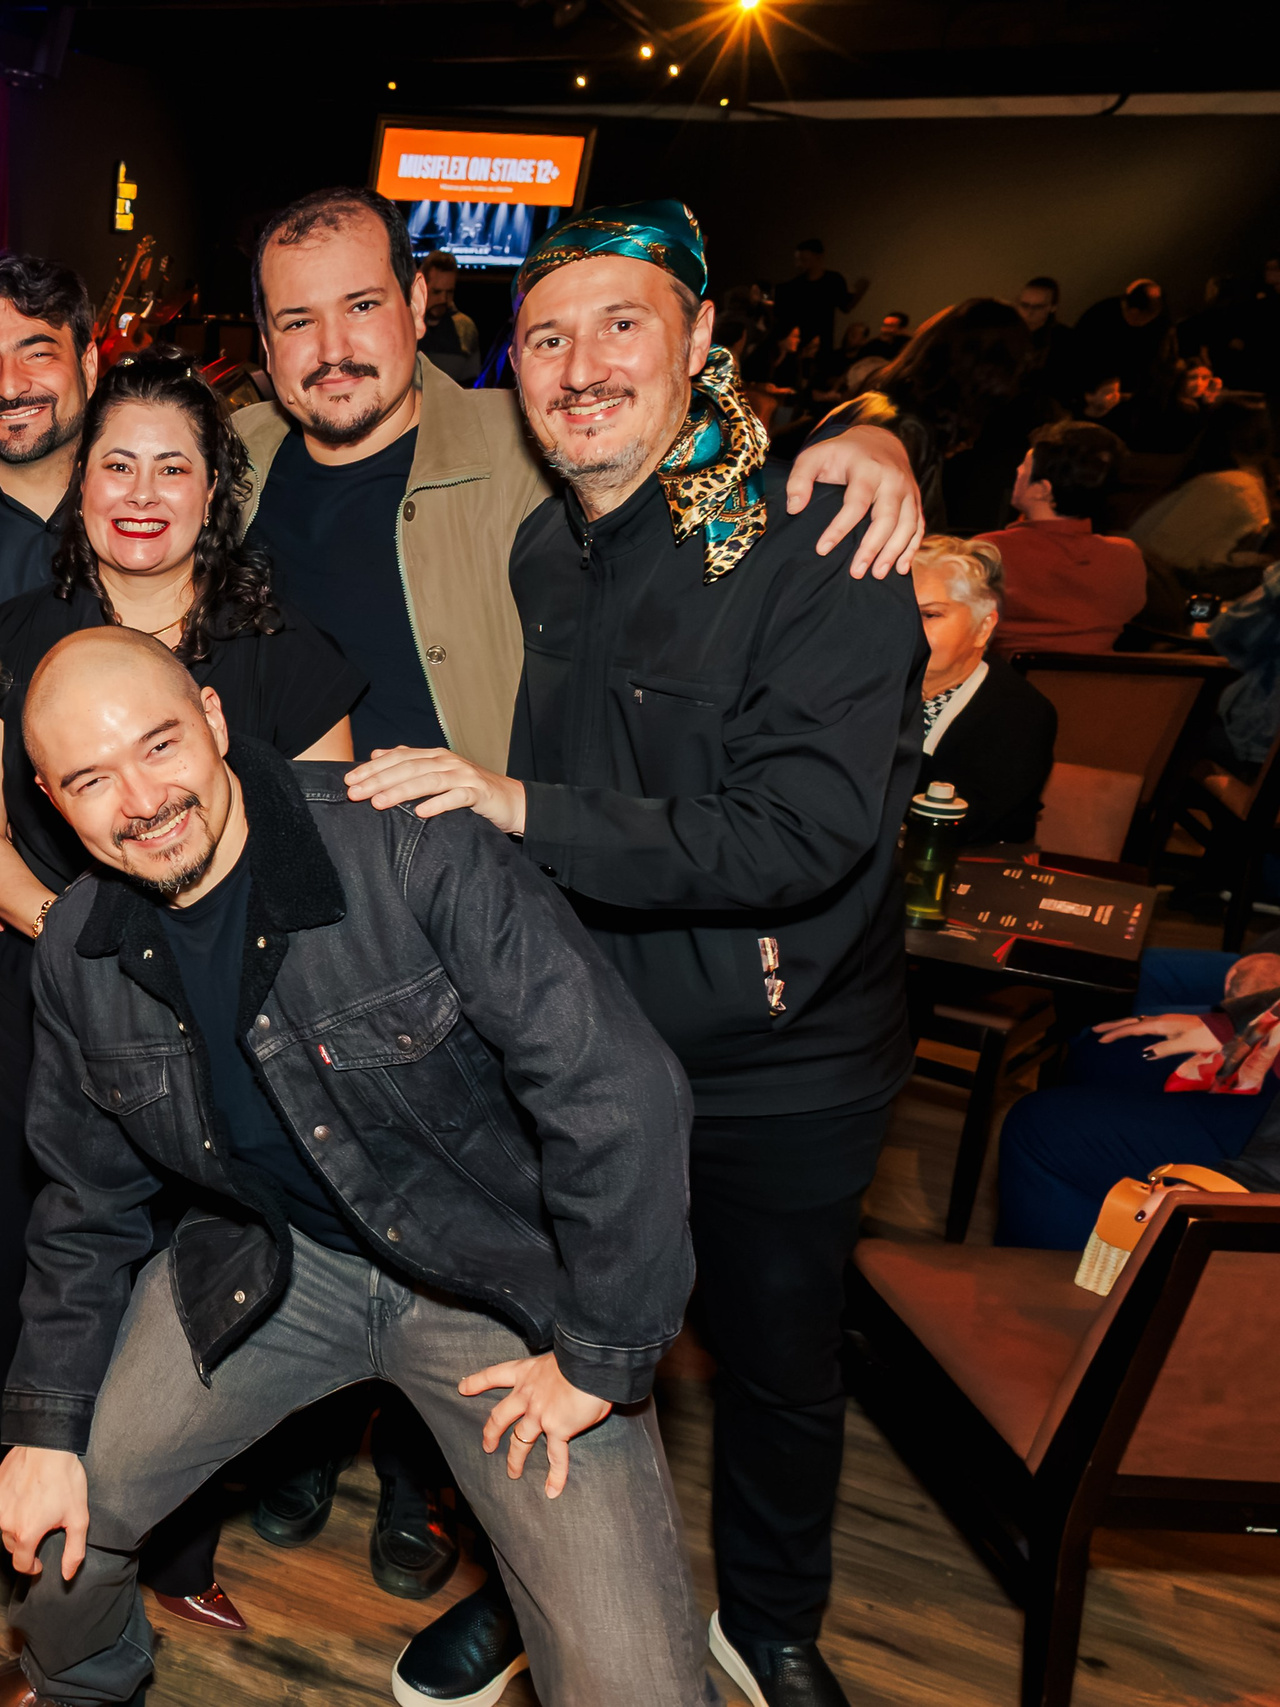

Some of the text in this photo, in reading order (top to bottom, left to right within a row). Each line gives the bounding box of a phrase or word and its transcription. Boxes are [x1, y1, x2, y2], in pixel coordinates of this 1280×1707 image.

[397, 153, 560, 184] MUSIFLEX ON STAGE 12+
